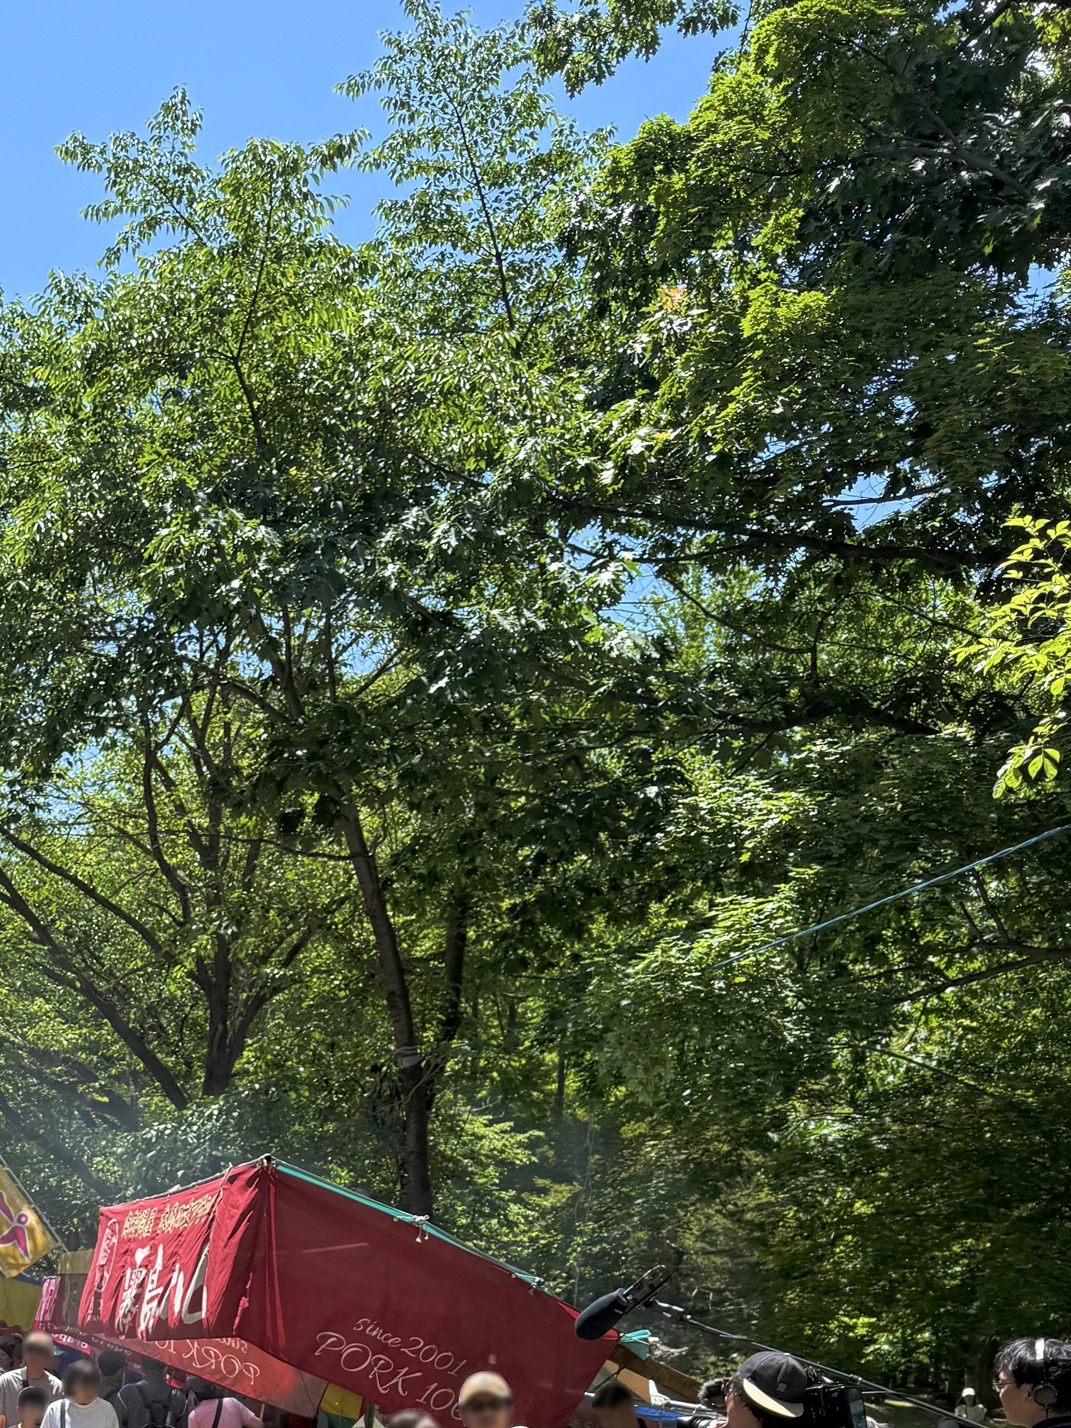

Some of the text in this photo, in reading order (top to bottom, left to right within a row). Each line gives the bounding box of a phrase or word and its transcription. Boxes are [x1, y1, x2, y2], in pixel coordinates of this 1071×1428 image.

[314, 1331, 423, 1396] PORK
[353, 1318, 468, 1377] since 2001
